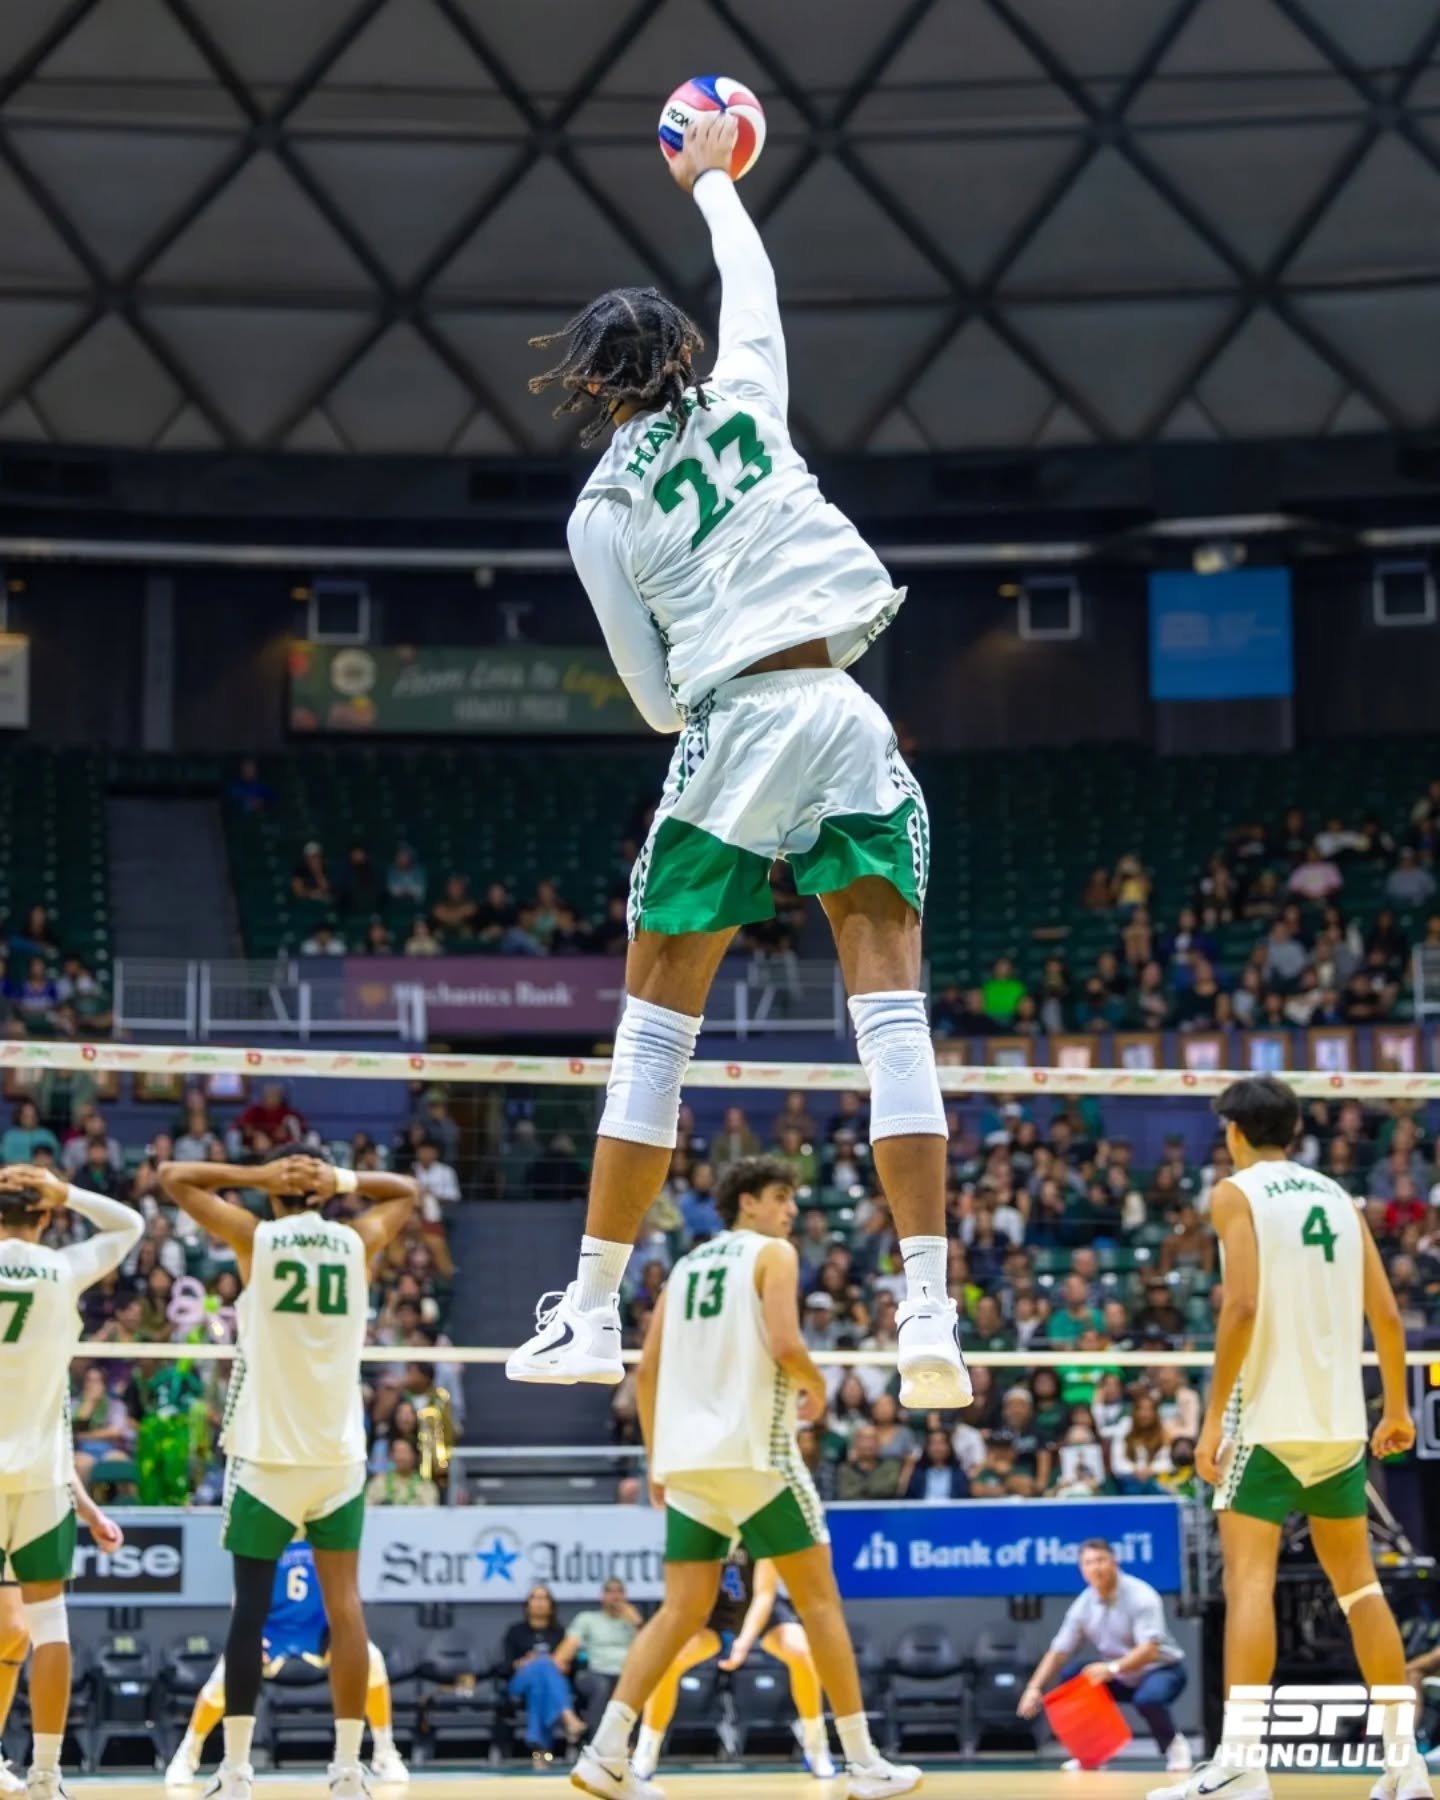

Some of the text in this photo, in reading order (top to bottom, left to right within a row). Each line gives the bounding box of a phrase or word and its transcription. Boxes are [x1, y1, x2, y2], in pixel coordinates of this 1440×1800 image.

[653, 411, 773, 552] 23
[515, 980, 572, 1007] Bank
[1301, 1205, 1339, 1264] 4
[273, 1260, 349, 1315] 20
[685, 1267, 728, 1320] 13
[0, 1290, 34, 1343] 7
[381, 1541, 471, 1588] Star
[909, 1538, 993, 1569] Bank
[995, 1536, 1033, 1567] of
[287, 1566, 309, 1602] 6
